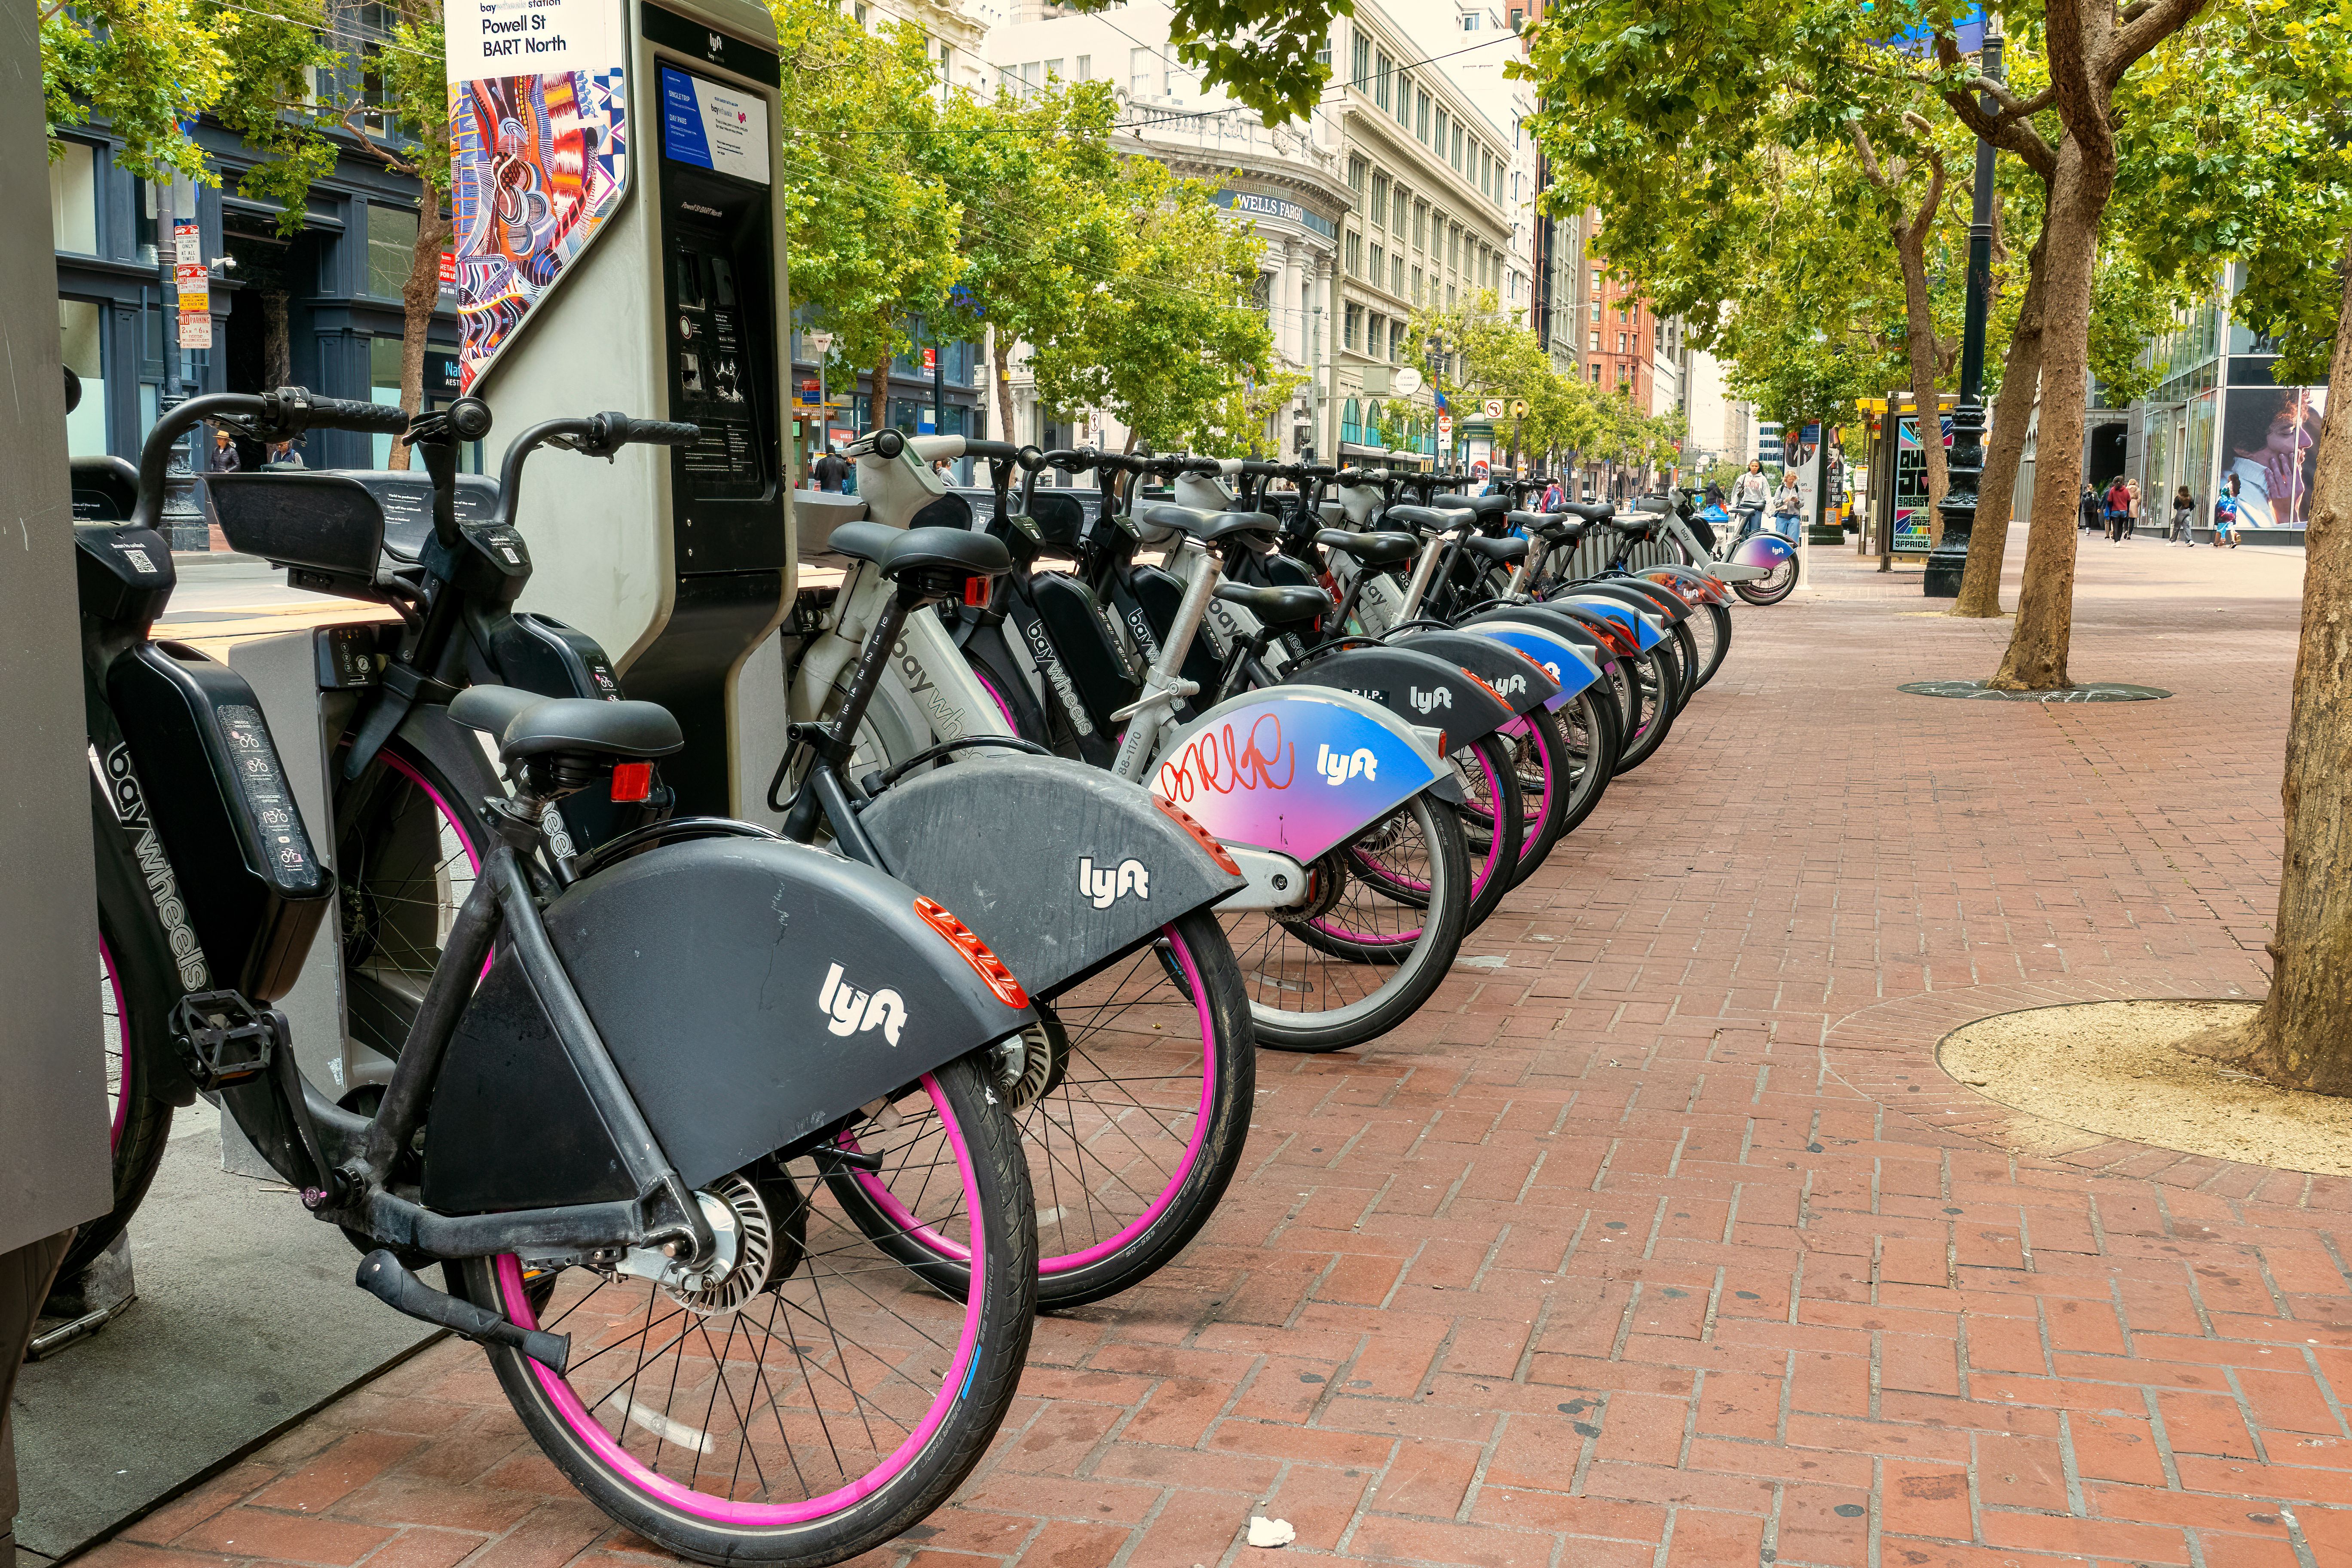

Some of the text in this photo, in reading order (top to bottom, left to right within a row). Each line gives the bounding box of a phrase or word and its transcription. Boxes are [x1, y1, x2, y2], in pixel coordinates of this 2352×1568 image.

[482, 14, 546, 34] Powell St
[483, 35, 566, 57] BART North
[710, 33, 722, 51] lyft
[1236, 193, 1303, 222] WELLS FARGO
[180, 314, 190, 325] NO
[1903, 496, 1929, 507] RESIST
[1681, 527, 1690, 542] bay
[1772, 546, 1784, 555] lyft
[1683, 588, 1699, 599] lyft
[1027, 619, 1093, 736] baywheels
[1487, 674, 1526, 698] yft
[1410, 686, 1452, 714] lyft
[1317, 744, 1378, 786] lyft
[107, 741, 206, 992] baywheels
[1079, 858, 1149, 909] lyft
[818, 962, 908, 1047] lyft
